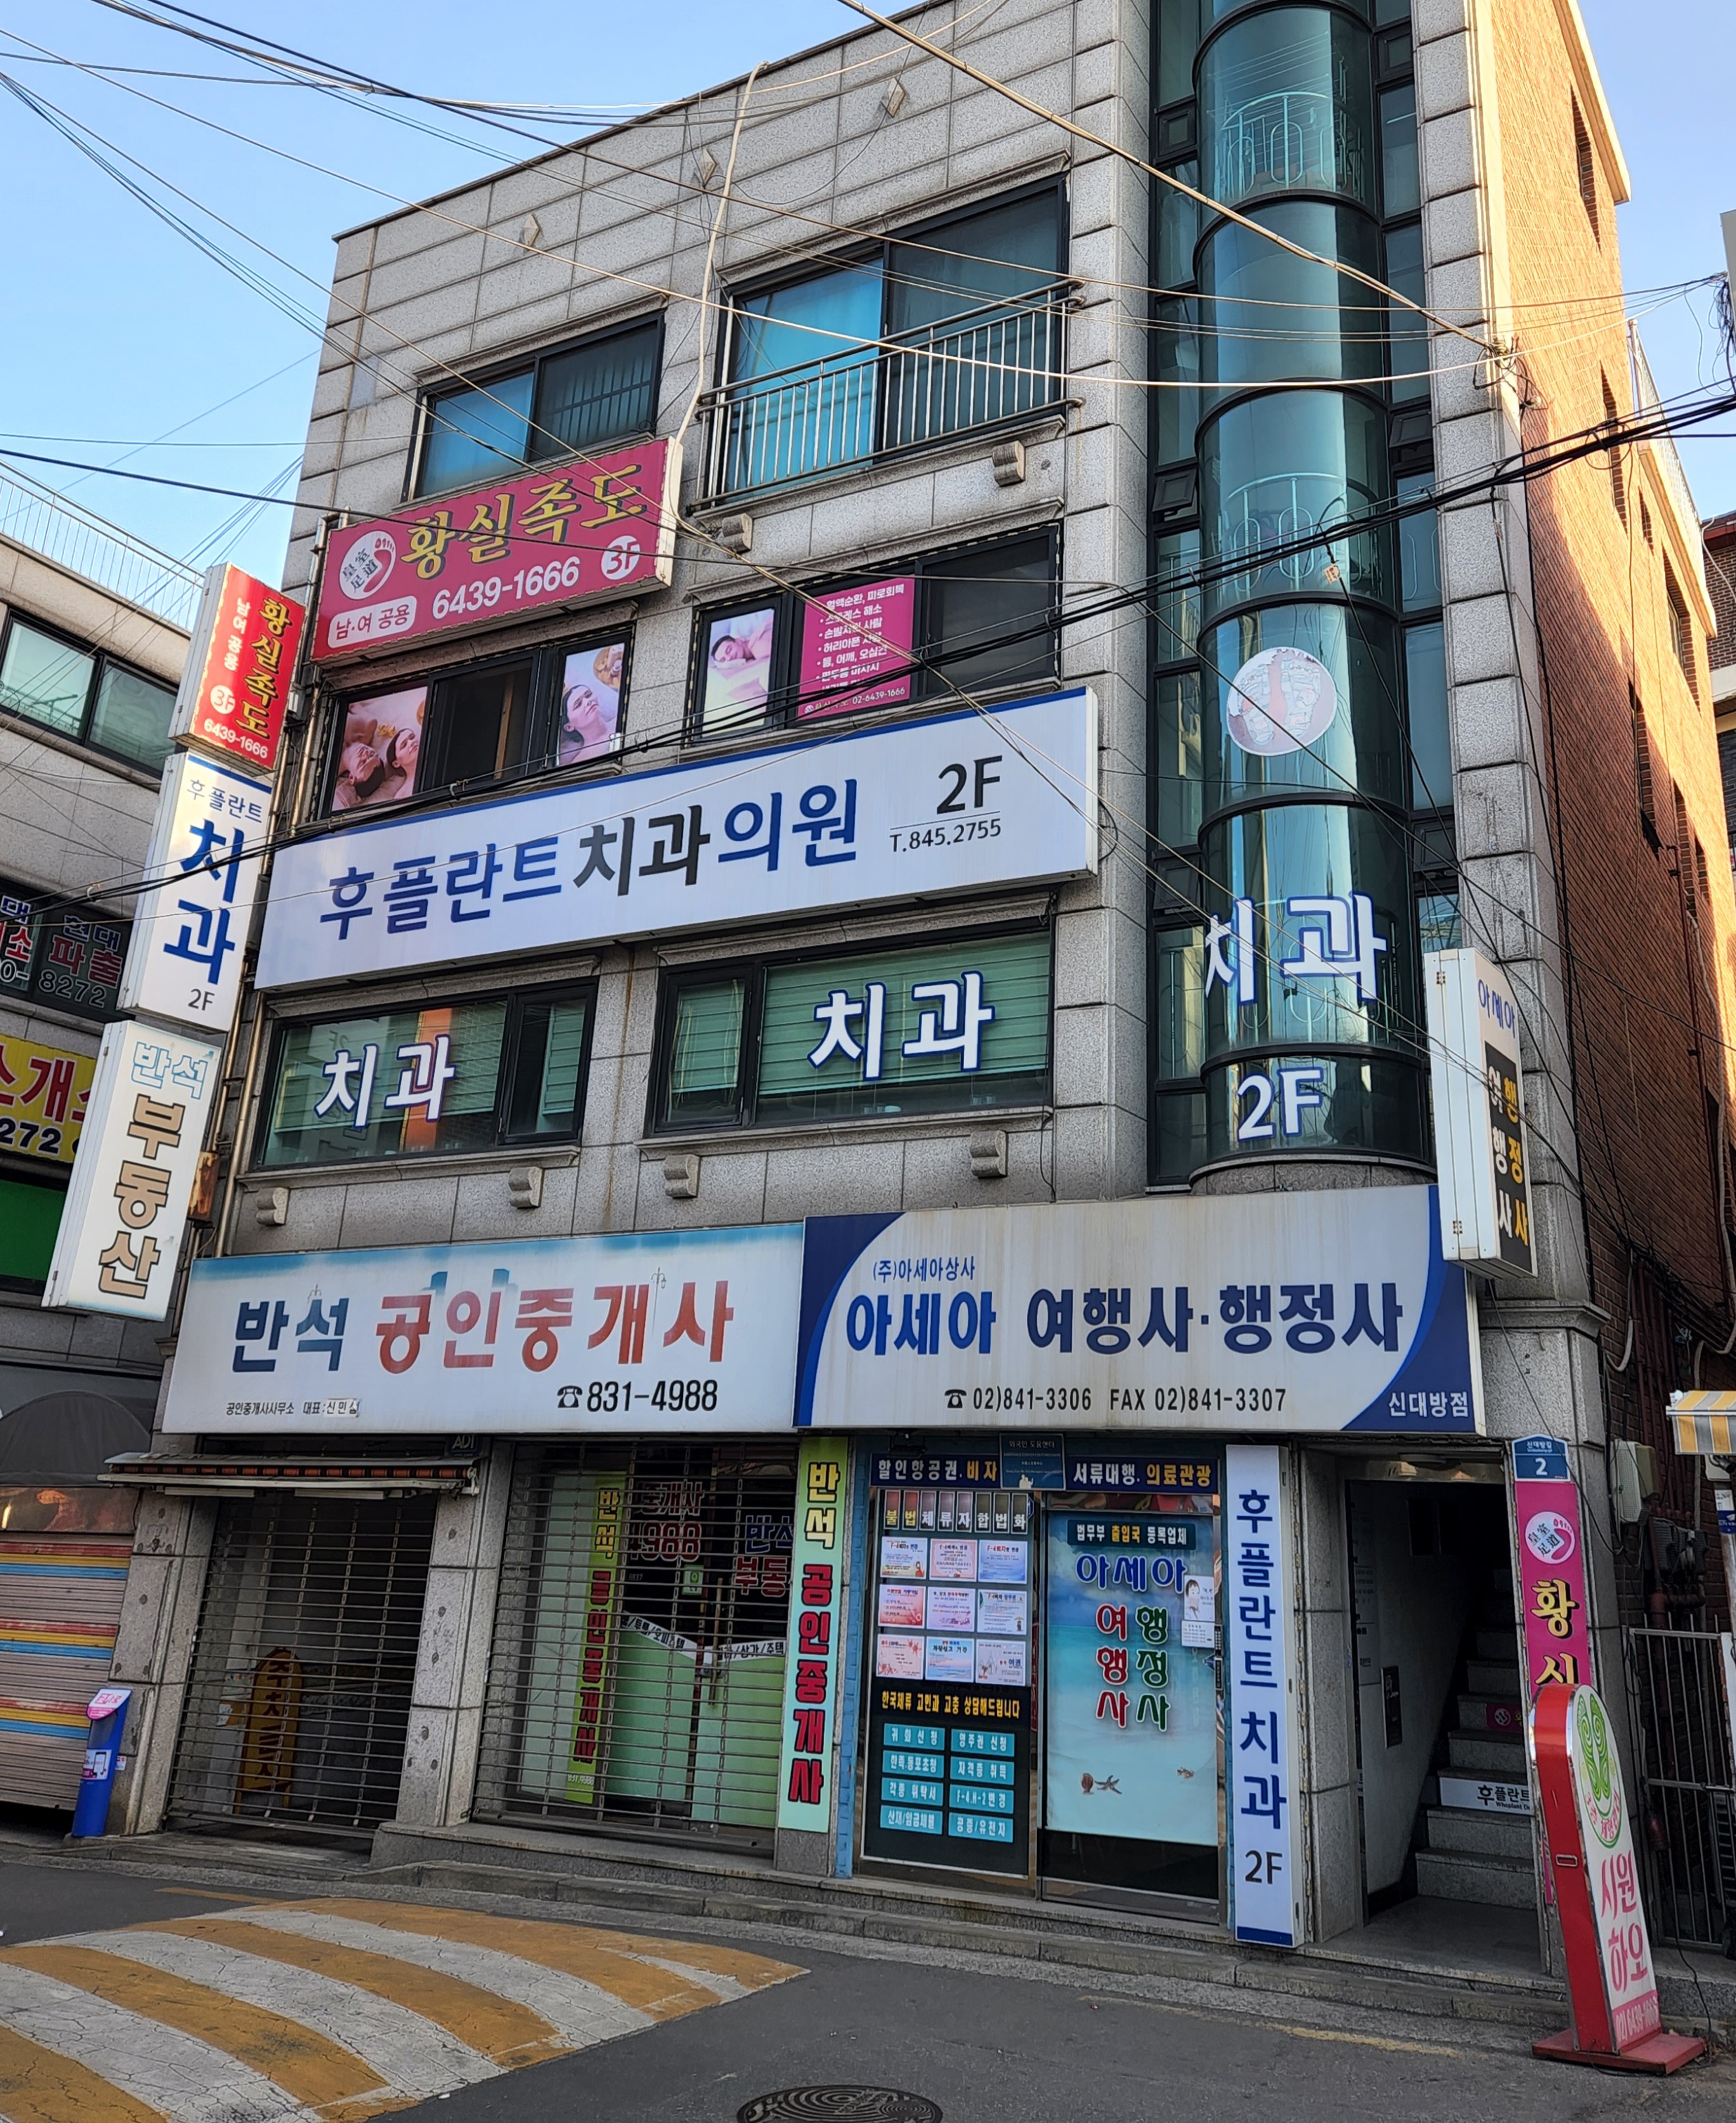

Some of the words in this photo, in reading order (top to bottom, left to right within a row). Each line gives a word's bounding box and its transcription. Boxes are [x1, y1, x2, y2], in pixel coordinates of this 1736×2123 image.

[400, 465, 646, 580] 황실족도
[605, 543, 641, 576] 3F
[432, 556, 580, 620] 6439-1666
[868, 584, 905, 602] 피로회복
[377, 604, 410, 630] 공용
[863, 604, 882, 616] 해소
[864, 617, 883, 630] 사람
[823, 637, 861, 653] 허리아픈
[235, 596, 292, 740] 황실족도
[211, 689, 235, 713] 3F
[852, 687, 906, 705] 02-6439-1666
[204, 718, 268, 760] 6439-1666
[187, 779, 263, 824] 후플란트
[936, 755, 1003, 815] 2F
[889, 818, 1002, 853] T.845.2755
[163, 819, 244, 985] 치과
[62, 914, 122, 952] 현대
[1206, 890, 1388, 1007] 치과
[48, 934, 124, 989] 파출
[39, 969, 107, 1009] 8272
[187, 988, 216, 1012] 2F
[807, 972, 996, 1082] 치과
[131, 1041, 209, 1101] 반석
[313, 1034, 456, 1129] 치과
[1236, 1066, 1327, 1141] 2F
[1487, 1064, 1513, 1240] 여행사
[1503, 1077, 1529, 1247] 행정사
[98, 1094, 187, 1299] 부동산
[872, 1255, 977, 1283] (주)아세아상사
[232, 1297, 350, 1374] 반석
[376, 1280, 736, 1375] 공인중개사
[846, 1289, 996, 1356] 아세아
[226, 1401, 295, 1416] 공인중개사사무소
[587, 1379, 719, 1413] 831-4988
[972, 1387, 1092, 1413] 02)841-3306
[1109, 1388, 1146, 1412] FAX
[1154, 1387, 1286, 1414] 02)841-3307
[1388, 1391, 1469, 1419] 신대방점
[967, 1460, 998, 1481] 비자
[1146, 1463, 1212, 1488] 의료관광
[1535, 1457, 1548, 1476] 2
[634, 1481, 705, 1517] 중개사
[804, 1462, 842, 1550] 반석
[595, 1486, 620, 1559] 반석
[1076, 1524, 1105, 1542] 법무부
[1111, 1524, 1141, 1544] 출입국
[1147, 1526, 1187, 1546] 등록업체
[1075, 1553, 1188, 1594] 아세아
[1236, 1489, 1278, 1689] 후플란트
[788, 1563, 834, 1805] 공인중개사
[1095, 1603, 1130, 1728] 여행사
[1135, 1605, 1172, 1732] 행정사
[882, 1690, 912, 1710] 한국체류
[916, 1693, 940, 1713] 고민과
[944, 1695, 960, 1715] 고충
[964, 1695, 1020, 1719] 상담해드립니다
[959, 1732, 984, 1750] 영주권
[990, 1735, 1007, 1752] 신청
[889, 1781, 906, 1798] 각종
[958, 1760, 984, 1778] 자격증
[990, 1763, 1007, 1780] 취득
[1239, 1710, 1287, 1831] 치과
[1477, 1784, 1530, 1806] 후플란트
[1244, 1848, 1284, 1886] 2F
[1600, 1850, 1638, 1922] 시원
[1607, 1921, 1648, 1994] 하오
